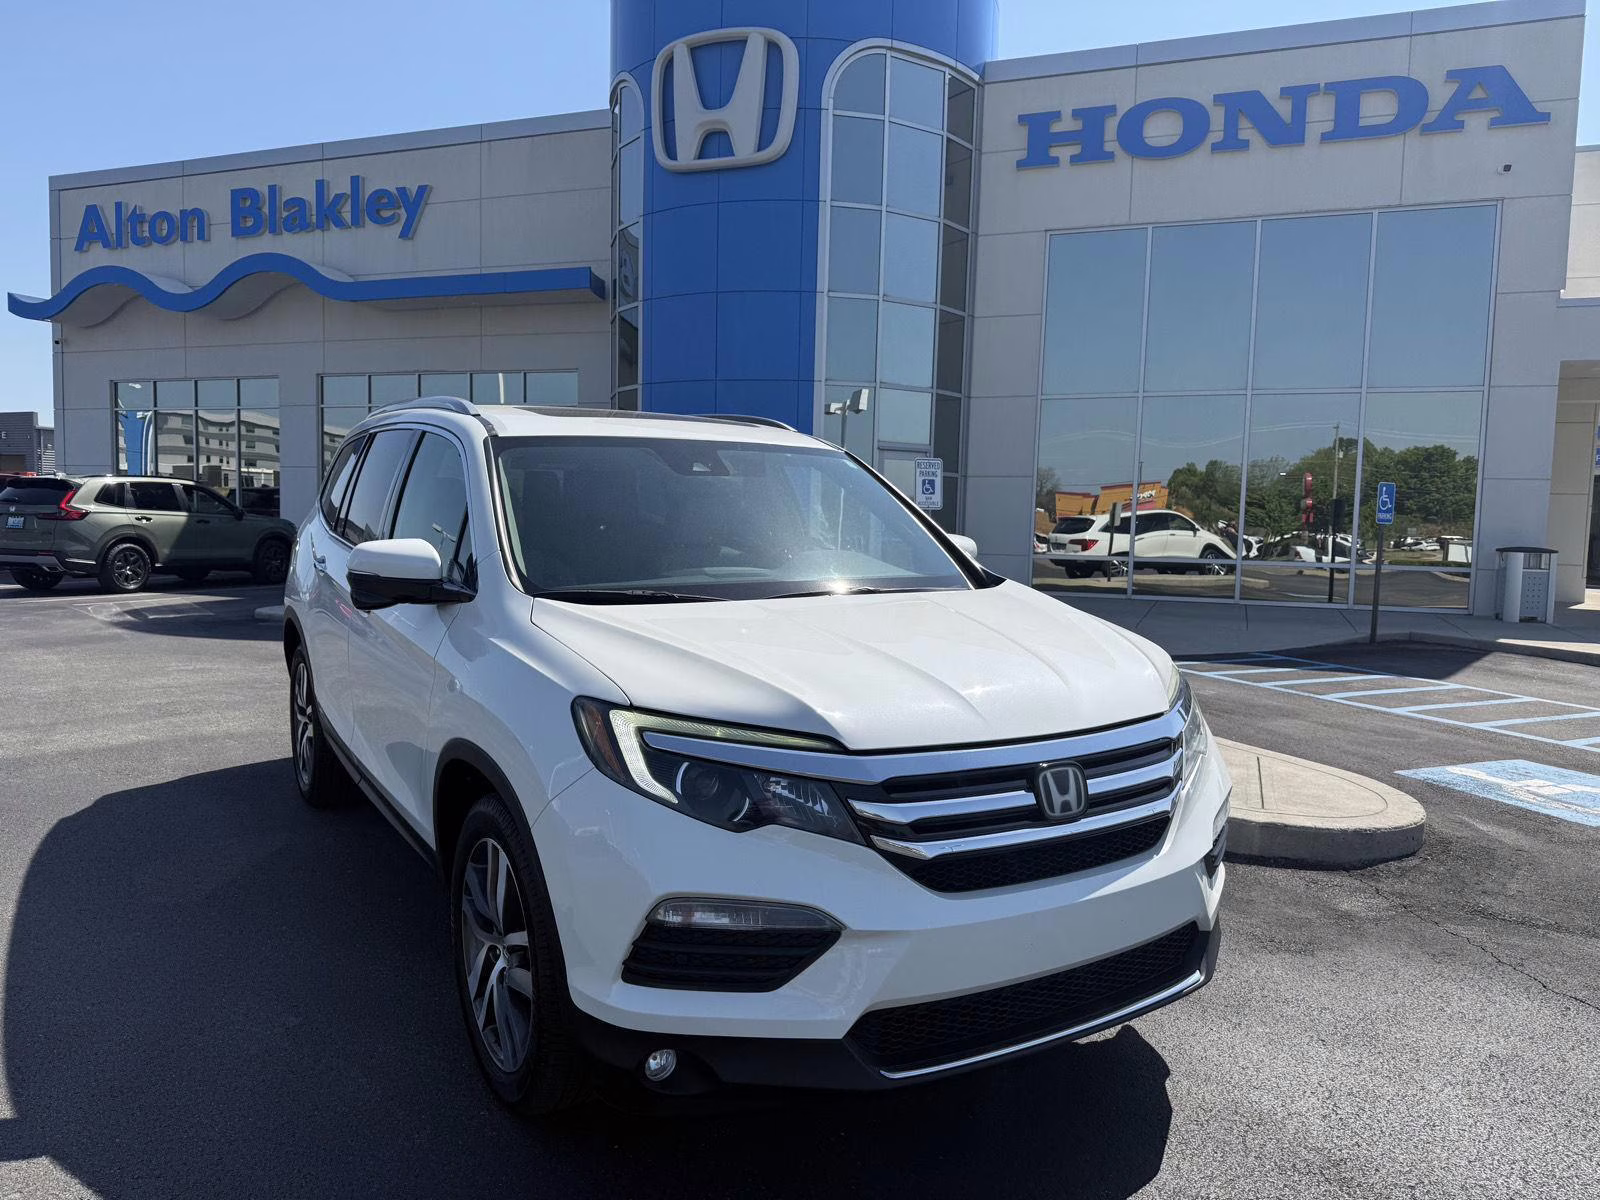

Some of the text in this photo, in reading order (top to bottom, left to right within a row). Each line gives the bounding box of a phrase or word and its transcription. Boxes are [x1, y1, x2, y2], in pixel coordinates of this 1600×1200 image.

[1016, 65, 1551, 170] HONDA
[74, 175, 431, 252] Alton Blakley
[916, 461, 940, 469] RESERVED
